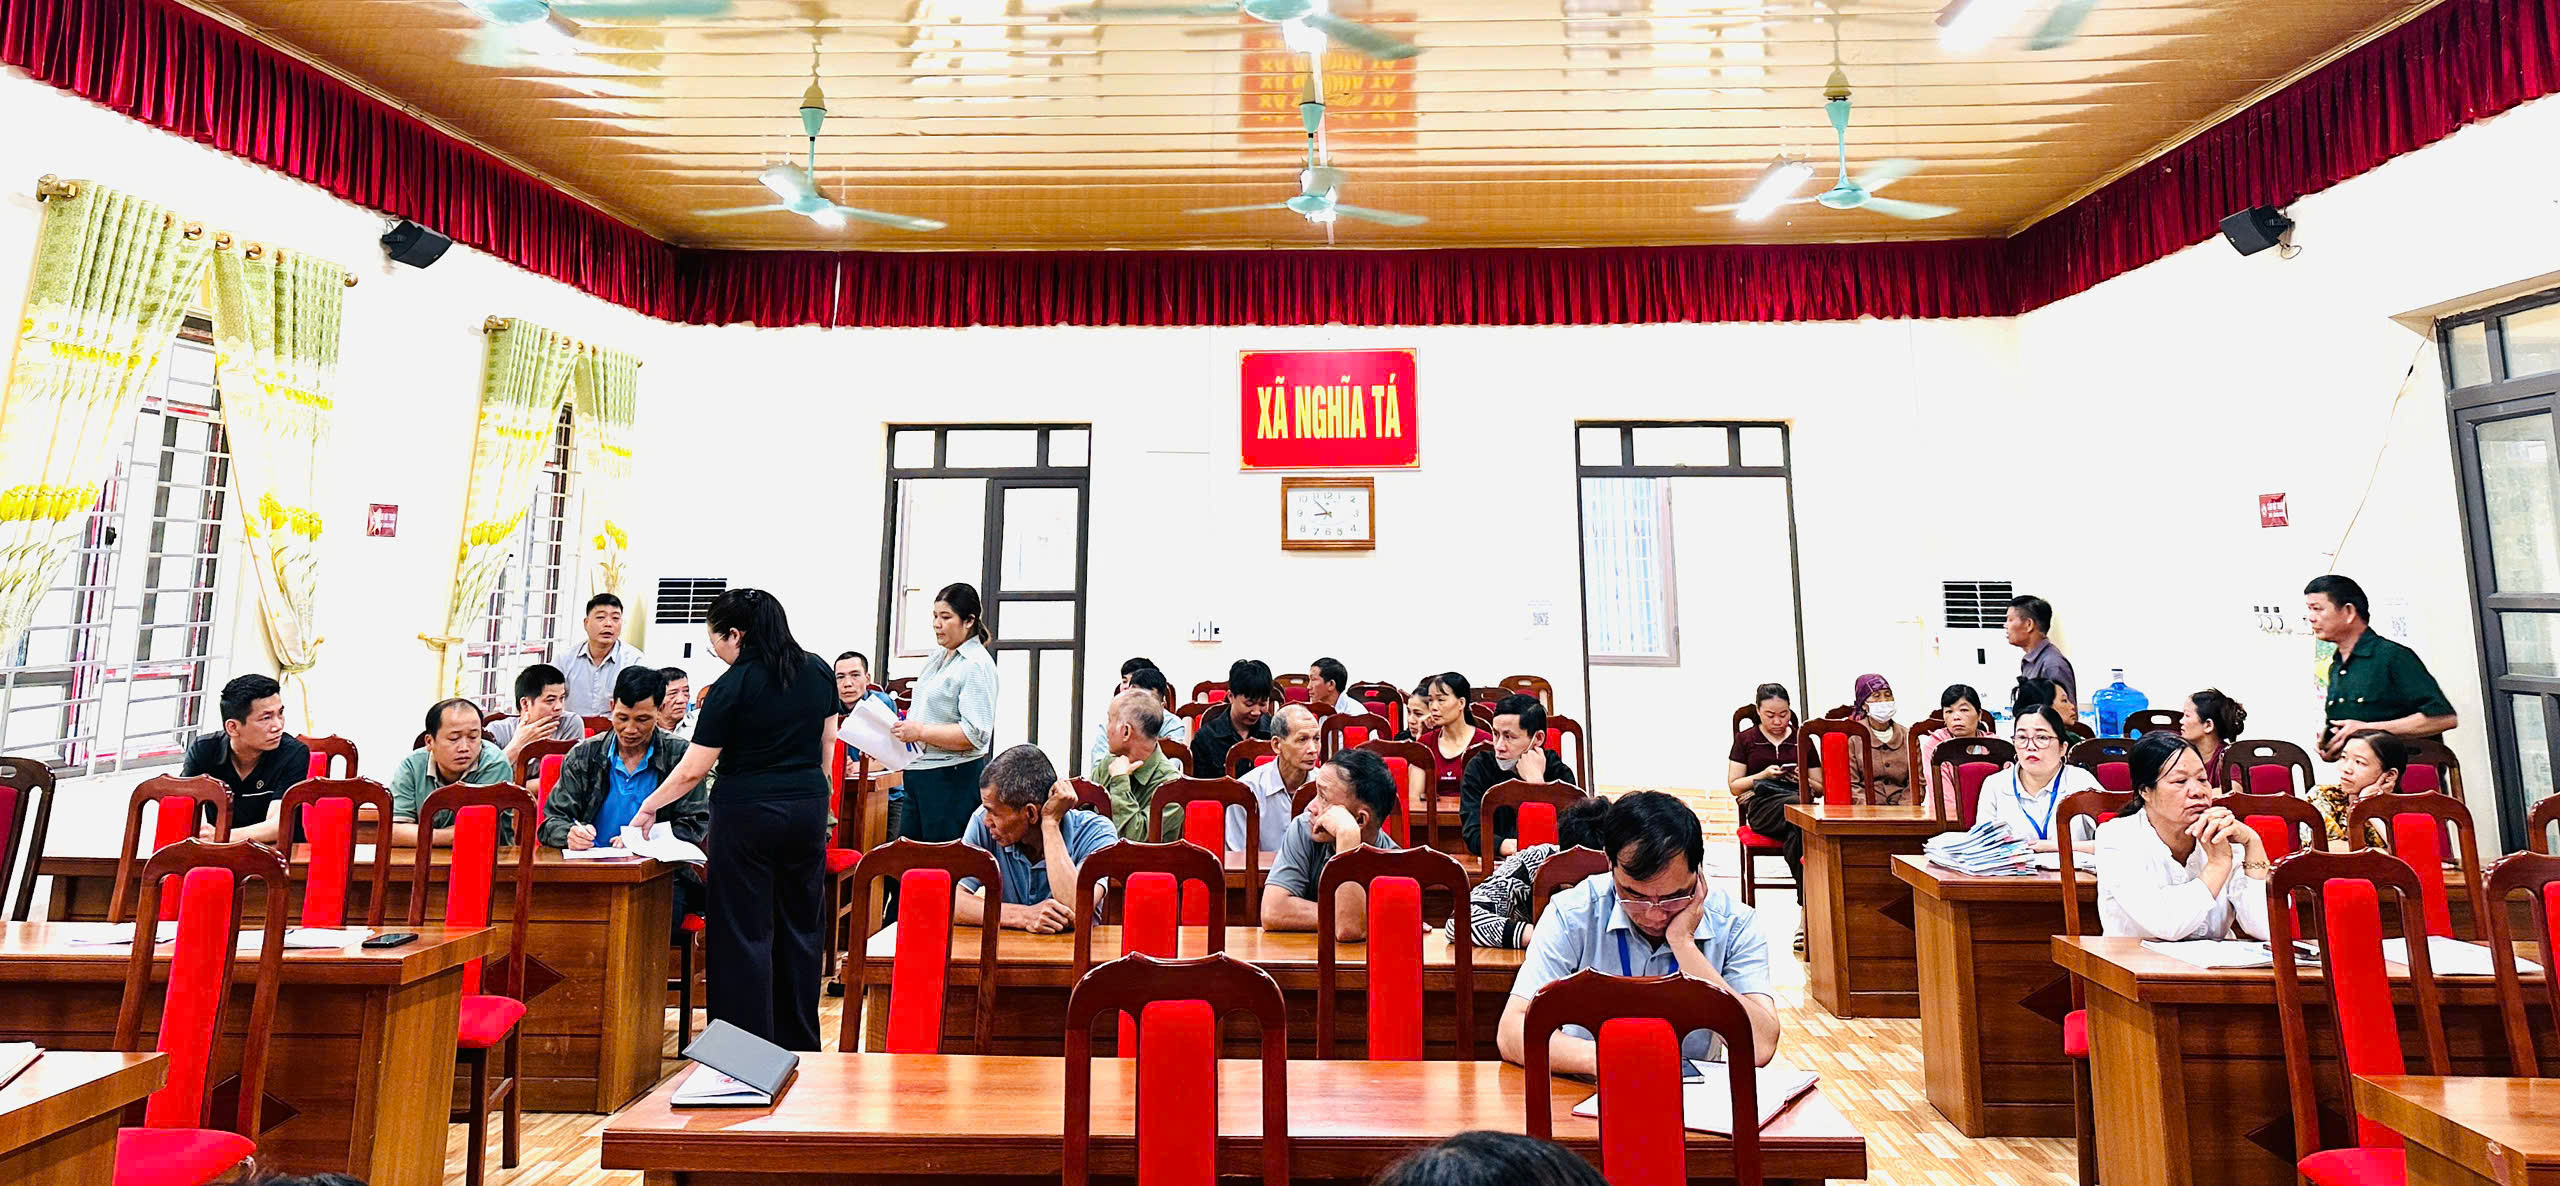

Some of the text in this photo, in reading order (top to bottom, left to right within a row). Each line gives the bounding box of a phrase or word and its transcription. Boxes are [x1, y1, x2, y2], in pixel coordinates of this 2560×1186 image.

[1257, 373, 1401, 439] XÃ NGHĨA TÁ
[1353, 510, 1359, 518] 3
